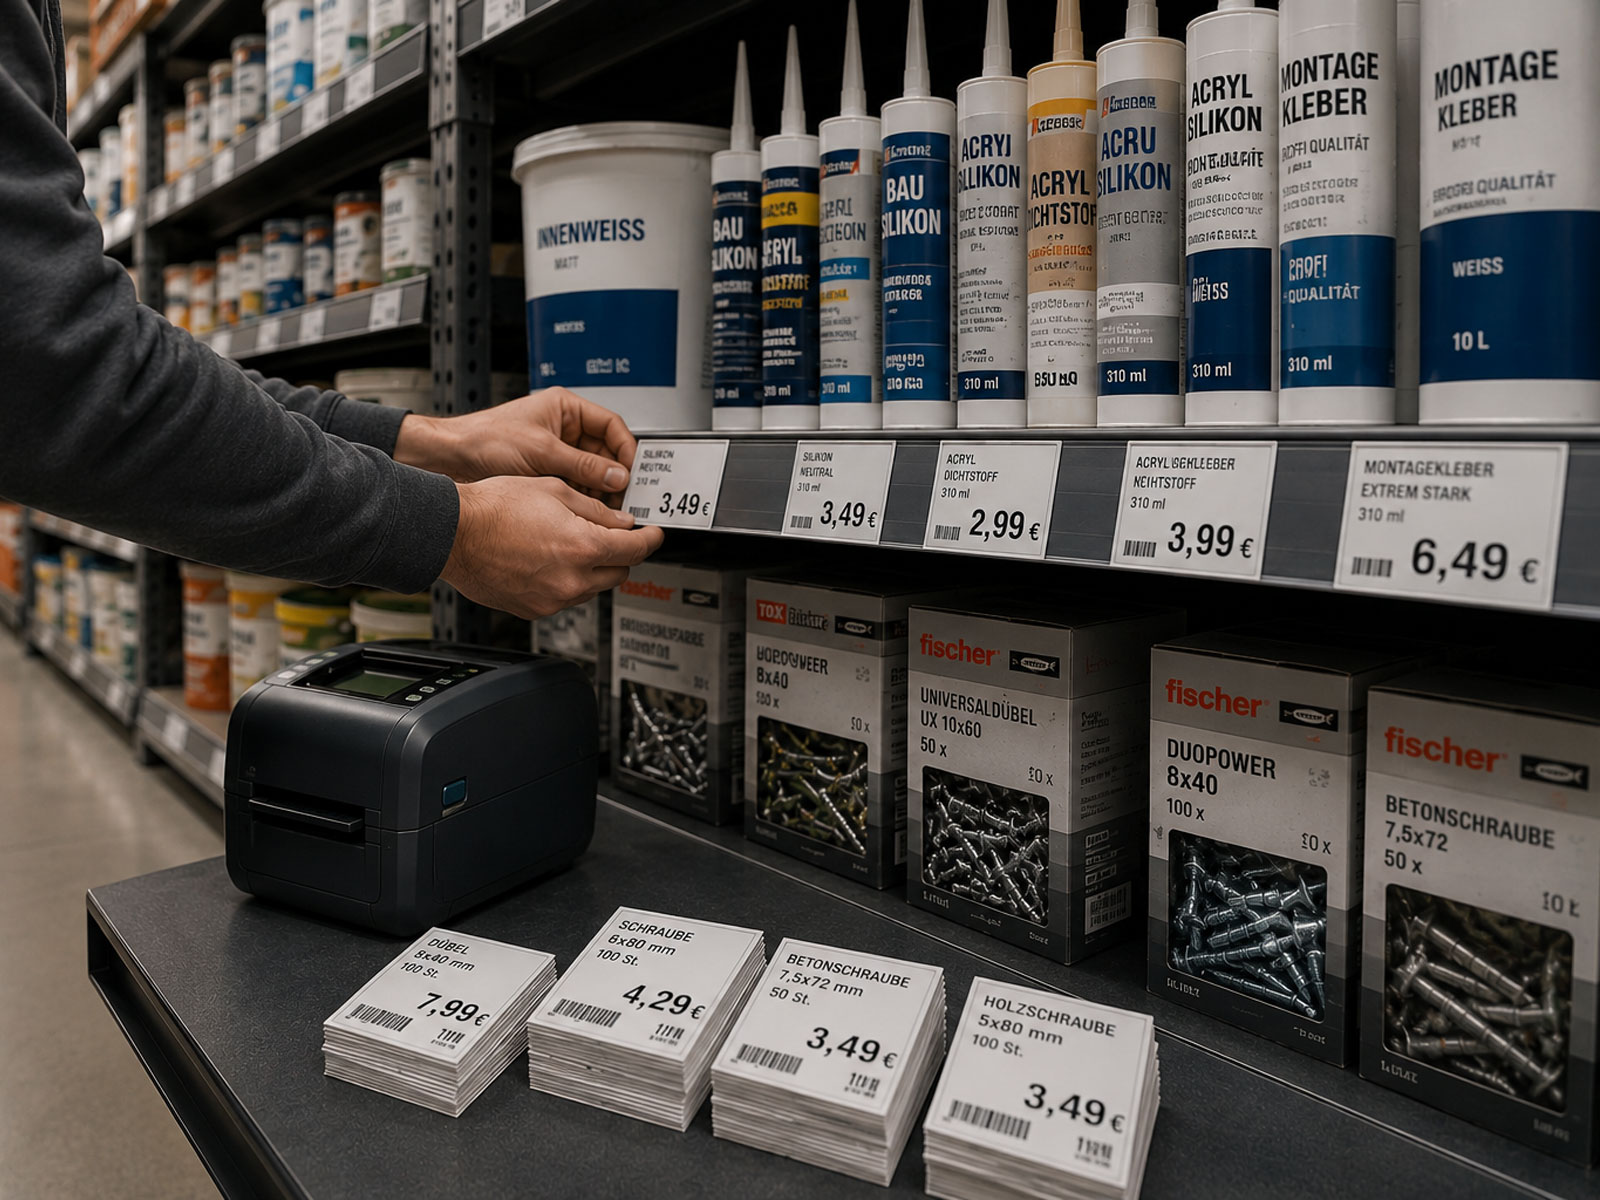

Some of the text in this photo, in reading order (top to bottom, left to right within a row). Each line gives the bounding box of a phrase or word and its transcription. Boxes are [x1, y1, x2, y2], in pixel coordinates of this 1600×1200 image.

[1281, 52, 1379, 93] MONTAGE
[1434, 50, 1559, 100] MONTAGE
[1191, 74, 1253, 108] ACRYL
[1282, 88, 1367, 127] KLEBER
[1438, 93, 1517, 132] KLEBER
[1188, 106, 1262, 142] SILIKON
[1100, 127, 1156, 161] ACRU
[886, 175, 924, 203] BAU
[1031, 170, 1090, 200] ACRYL
[1096, 163, 1171, 198] SILIKON
[537, 218, 646, 250] INNENWEISS
[713, 217, 743, 242] BAU
[1453, 256, 1504, 278] WEISS
[1452, 330, 1490, 351] 10 L
[1107, 368, 1147, 384] 310 ml
[1192, 362, 1232, 378] 310 ml
[1288, 355, 1333, 372] 310 ml
[837, 381, 851, 394] ml
[964, 375, 999, 390] 310 ml
[946, 453, 976, 466] ACRYL
[1364, 460, 1495, 478] MONTAGEKLEBER
[797, 482, 810, 493] 310
[944, 469, 999, 483] DICHTSTOFF
[659, 492, 711, 518] 3,49 €
[941, 487, 970, 499] 310 ml
[1130, 496, 1166, 510] 310 ml
[1361, 483, 1472, 502] EXTREM STARK
[820, 500, 878, 530] 3,49 €
[969, 509, 1041, 543] 2,99 €
[1358, 508, 1405, 523] 310 ml
[1167, 522, 1254, 559] 3,99 €
[1411, 538, 1539, 584] 6,49 €
[758, 602, 785, 621] TOX
[920, 633, 996, 667] fischer
[921, 686, 1038, 727] UNIVERSALDÜBEL
[1165, 678, 1263, 718] fischer
[864, 721, 871, 734] x
[921, 710, 982, 739] UX 10x60
[920, 736, 948, 758] 50 x
[1167, 738, 1276, 780] DUOPOWER
[1384, 726, 1502, 773] fischer
[1046, 773, 1054, 787] x
[1166, 765, 1219, 796] 8x40
[1166, 798, 1205, 822] 100 x
[1385, 794, 1556, 850] BETONSCHRAUBE
[1322, 839, 1332, 855] x
[1384, 821, 1449, 853] 7,5x72
[1384, 849, 1423, 875] 50 x
[618, 919, 695, 943] SCHRAUBE
[597, 949, 639, 967] 100 St.
[648, 942, 677, 956] mm
[400, 961, 440, 979] 100 St.
[449, 960, 475, 972] mm
[786, 953, 912, 989] BETONSCHRAUBE
[769, 986, 811, 1006] 50 St.
[778, 969, 864, 997] 7,5x72 mm
[983, 995, 1117, 1038] HOLZSCHRAUBE
[978, 1014, 1064, 1046] 5x80 mm
[806, 1027, 881, 1063] 3,49
[972, 1033, 1024, 1058] 100 St.
[1023, 1083, 1106, 1127] 3,49
